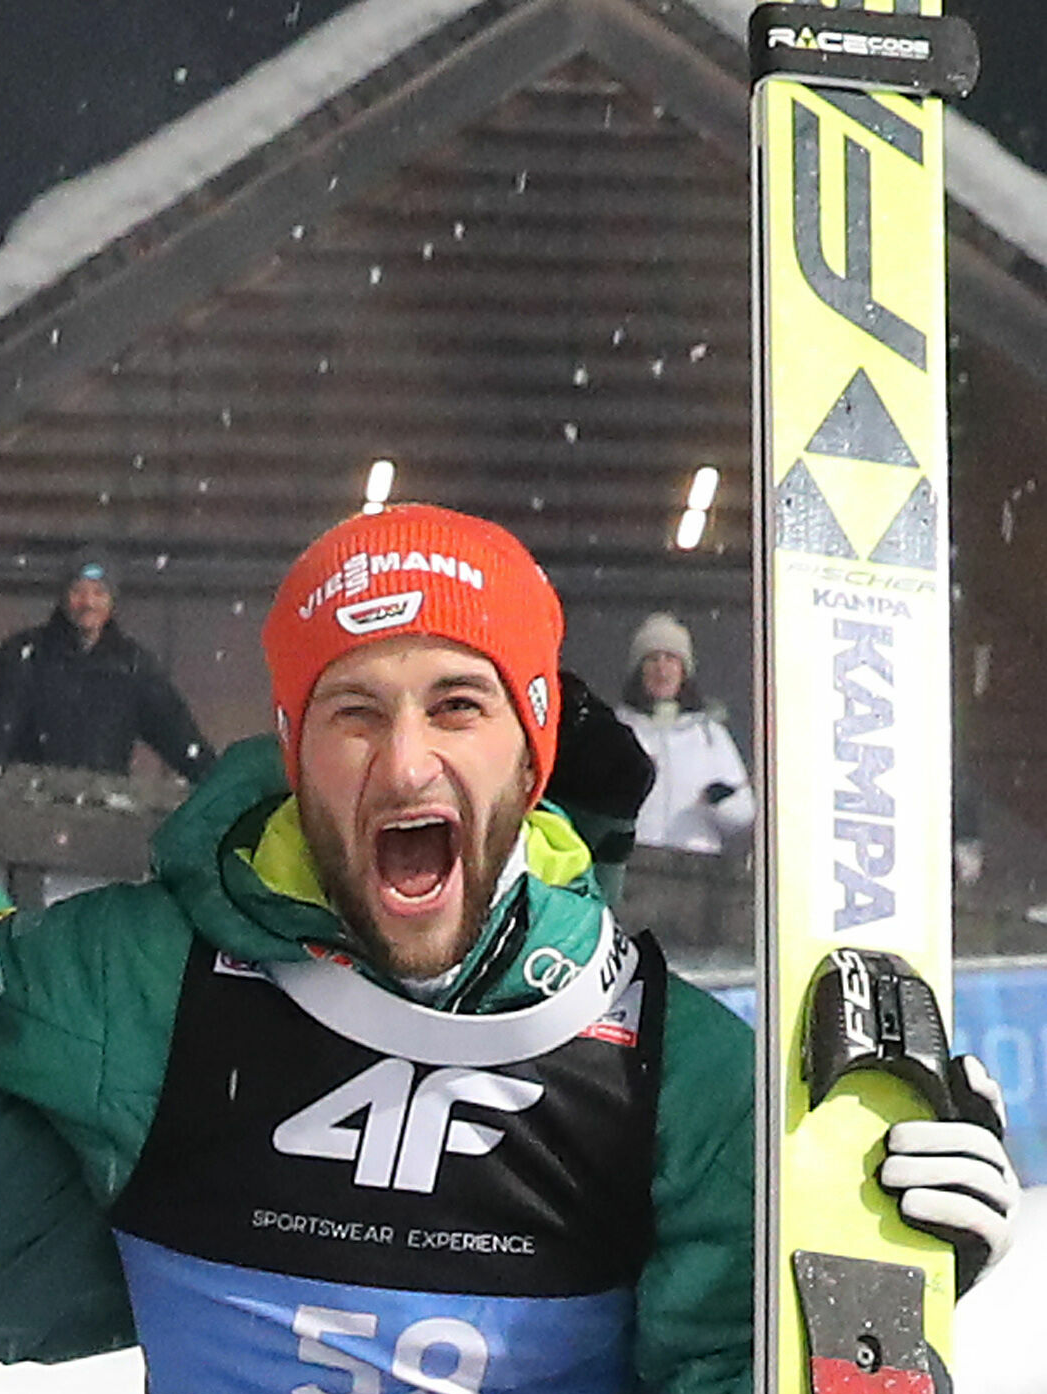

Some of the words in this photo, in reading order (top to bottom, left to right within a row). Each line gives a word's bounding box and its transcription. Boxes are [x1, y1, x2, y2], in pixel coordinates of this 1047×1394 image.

[298, 551, 484, 620] VIESSMANN
[813, 588, 913, 619] KAMPA
[833, 618, 896, 932] KAMPA
[272, 1058, 545, 1194] 4F
[252, 1209, 394, 1246] SPORTSWEAR
[407, 1229, 535, 1255] EXPERIENCE
